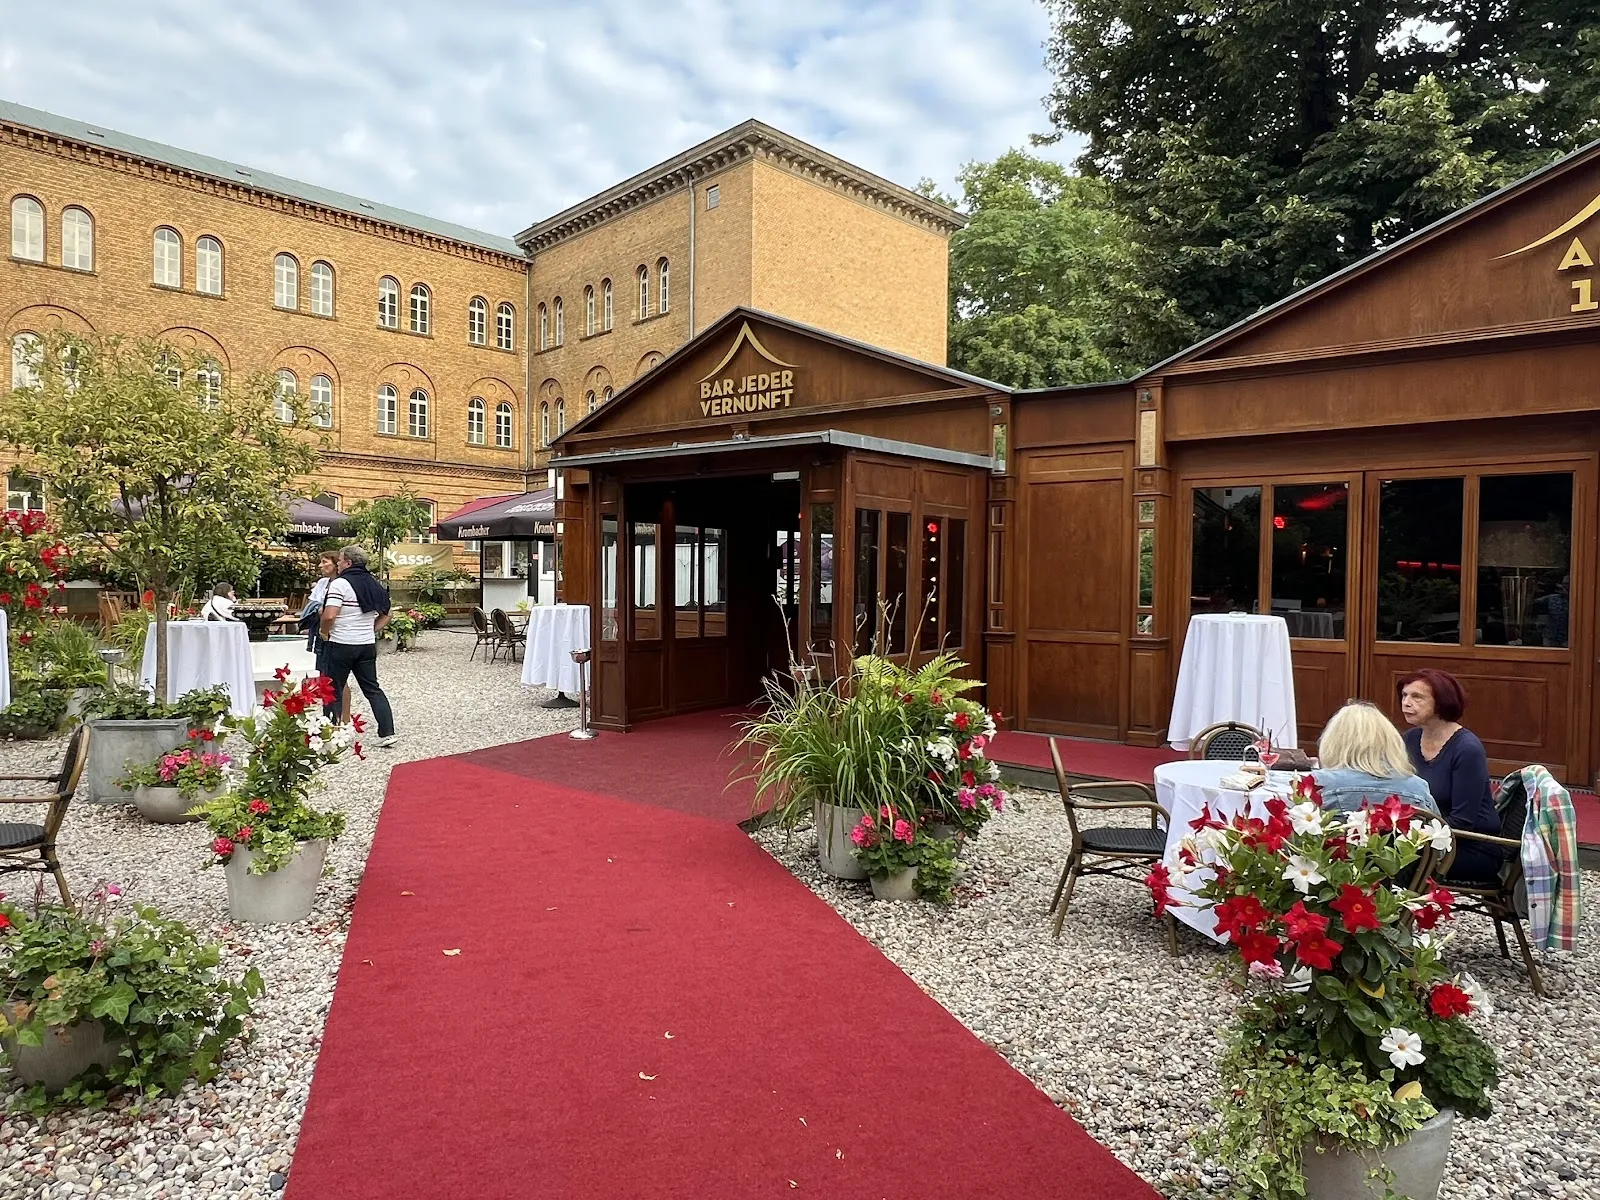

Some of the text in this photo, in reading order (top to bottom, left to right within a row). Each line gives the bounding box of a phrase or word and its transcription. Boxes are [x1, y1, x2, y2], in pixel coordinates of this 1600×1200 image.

[1557, 236, 1600, 271] A
[700, 369, 794, 399] BAR JEDER
[700, 388, 794, 418] VERNUNFT
[292, 521, 331, 536] mbacher
[457, 524, 490, 539] Krombacher
[533, 521, 555, 534] Kromb
[386, 550, 433, 566] Kasse
